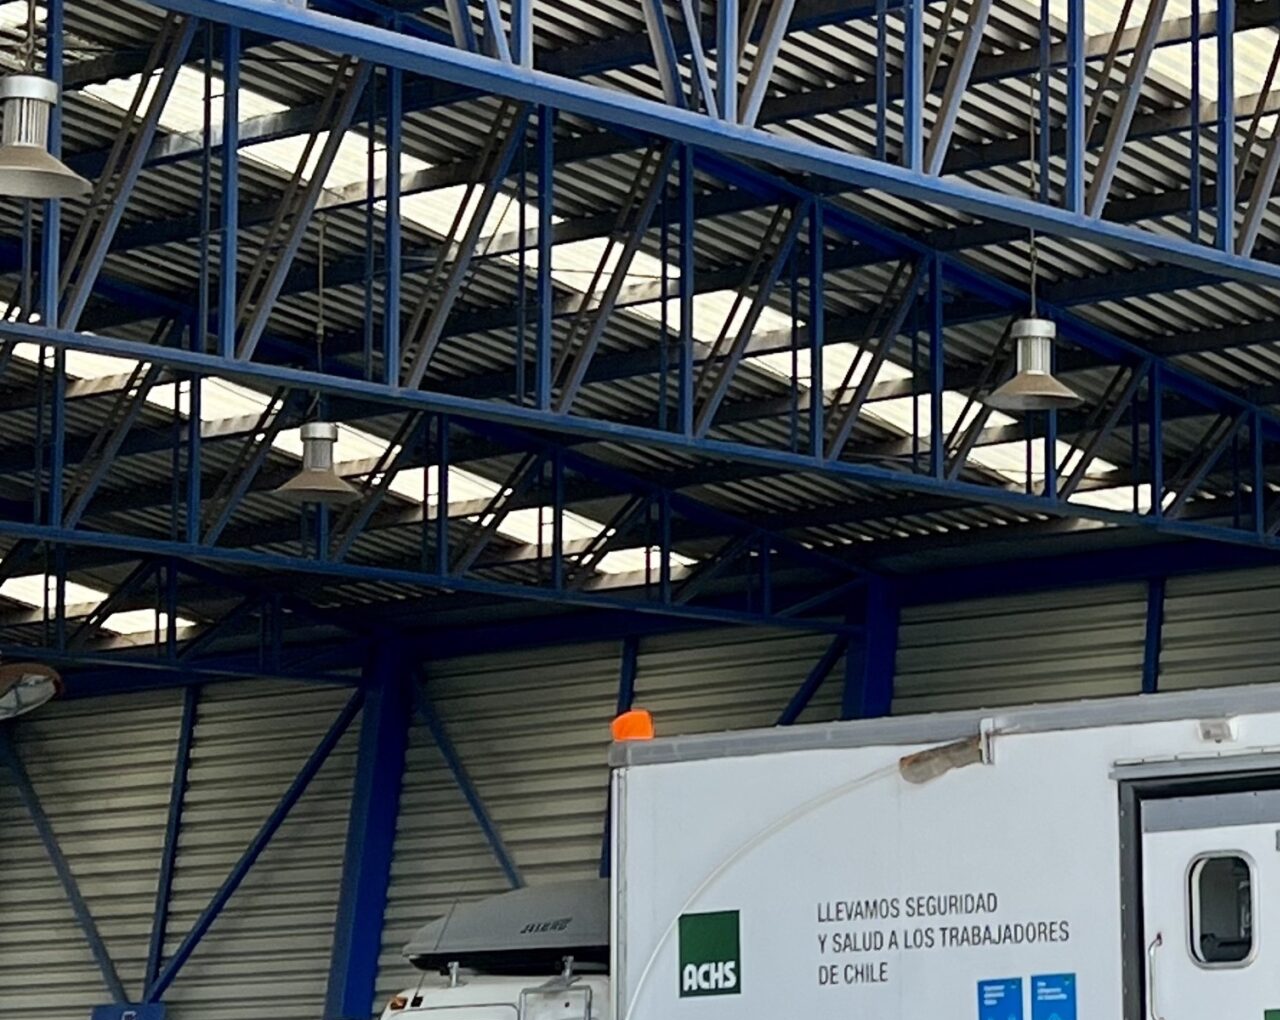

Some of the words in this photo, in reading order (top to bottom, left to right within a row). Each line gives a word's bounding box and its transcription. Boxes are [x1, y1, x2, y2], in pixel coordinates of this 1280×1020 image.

[817, 898, 901, 923] LLEVAMOS
[905, 892, 998, 918] SEGURIDAD
[817, 935, 828, 954] Y
[832, 930, 884, 953] SALUD
[887, 930, 899, 951] A
[903, 927, 935, 950] LOS
[939, 920, 1070, 949] TRABAJADORES
[682, 960, 737, 992] ACHS
[818, 964, 839, 986] DE
[843, 961, 889, 985] CHILE
